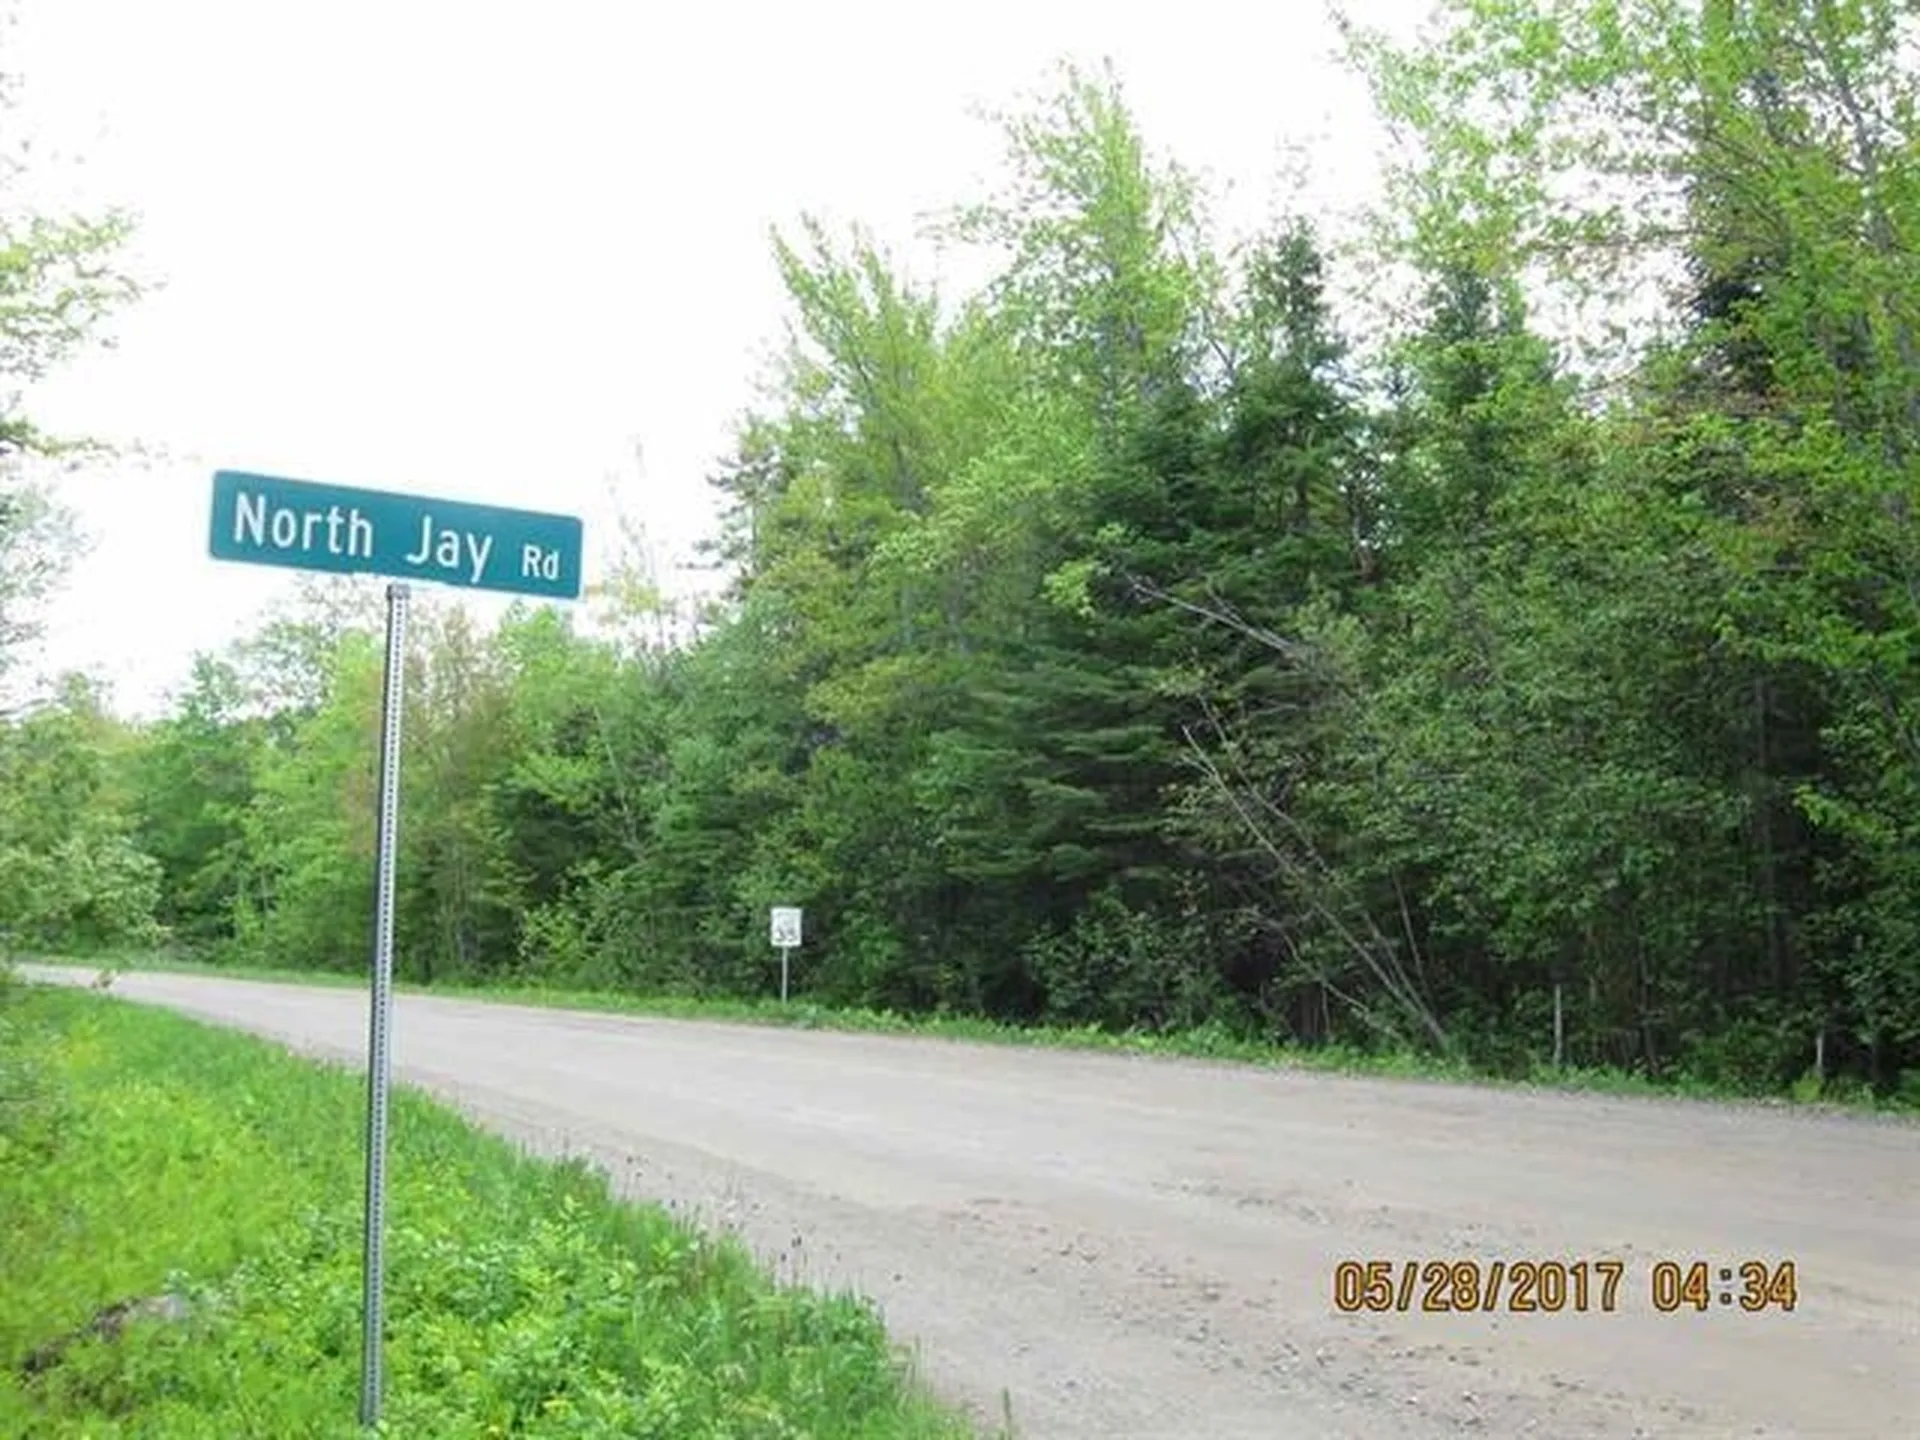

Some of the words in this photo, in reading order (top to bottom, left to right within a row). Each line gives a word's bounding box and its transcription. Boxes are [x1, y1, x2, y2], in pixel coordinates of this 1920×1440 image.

[233, 492, 374, 558] North
[407, 515, 493, 583] Jay
[522, 545, 560, 581] Rd
